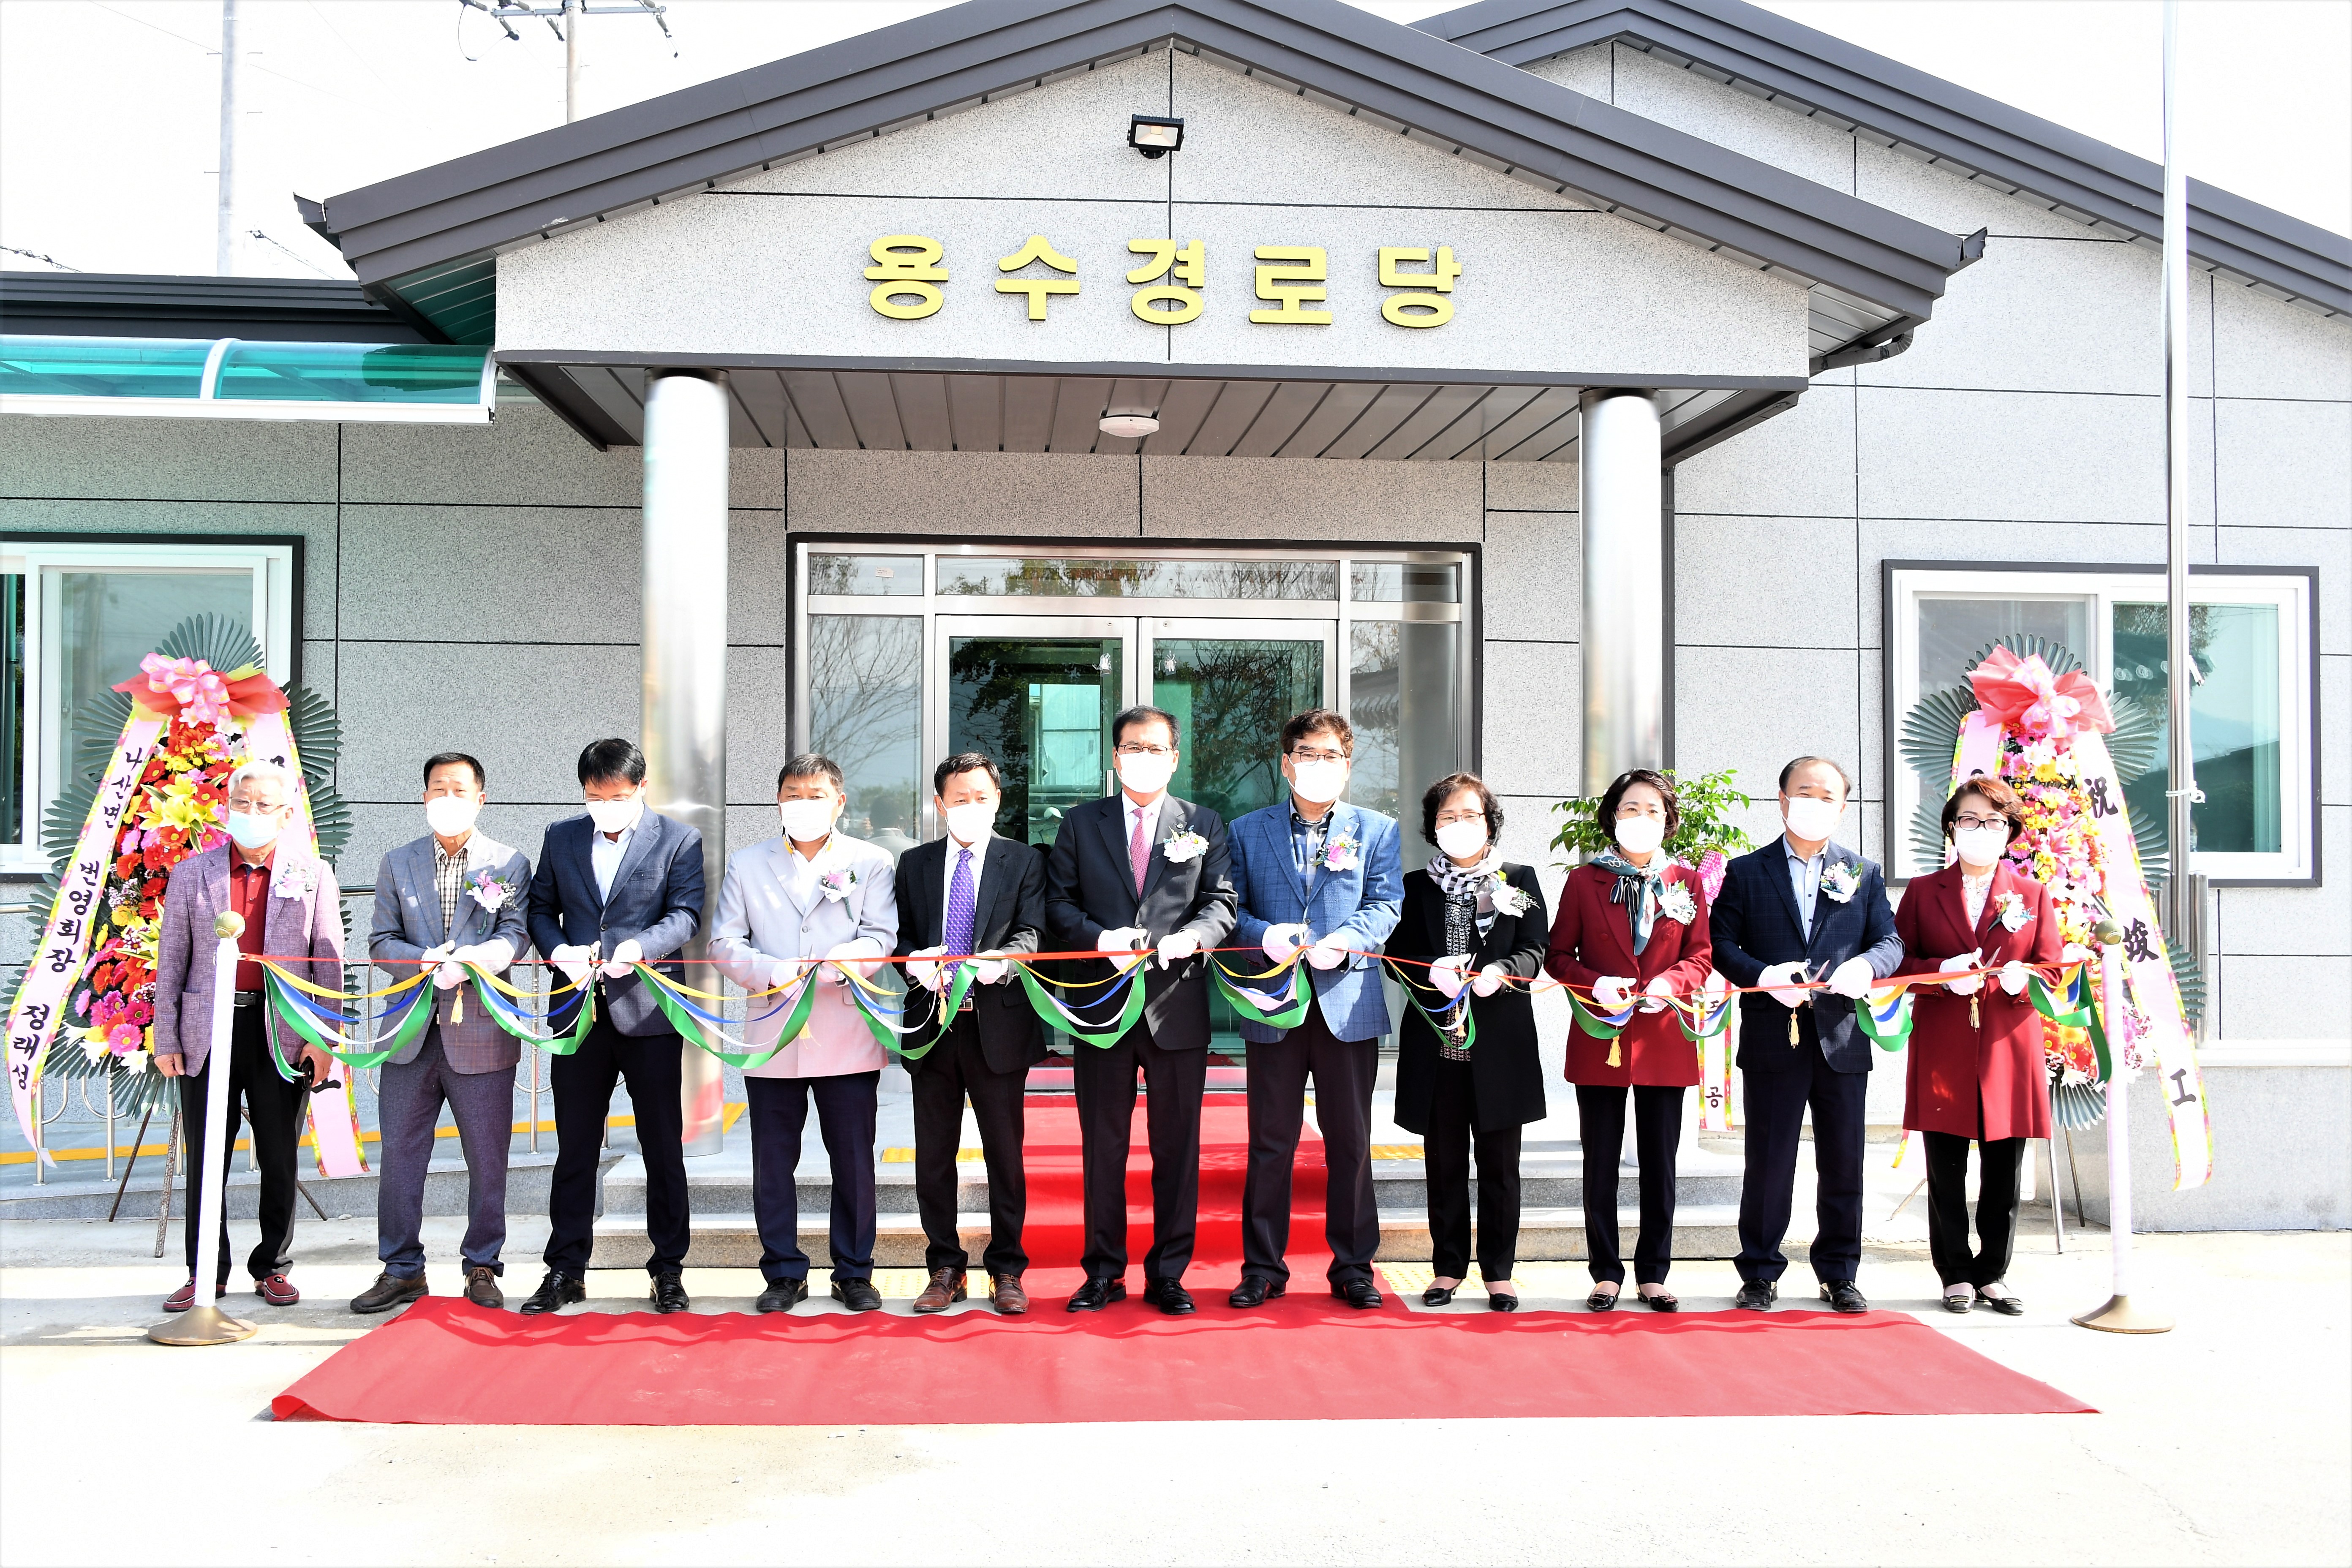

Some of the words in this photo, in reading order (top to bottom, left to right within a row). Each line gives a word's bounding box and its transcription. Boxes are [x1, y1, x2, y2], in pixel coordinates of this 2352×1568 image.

[863, 234, 1462, 329] 용수경로당
[46, 860, 100, 973] 번영회장
[12, 1003, 50, 1090] 정래성
